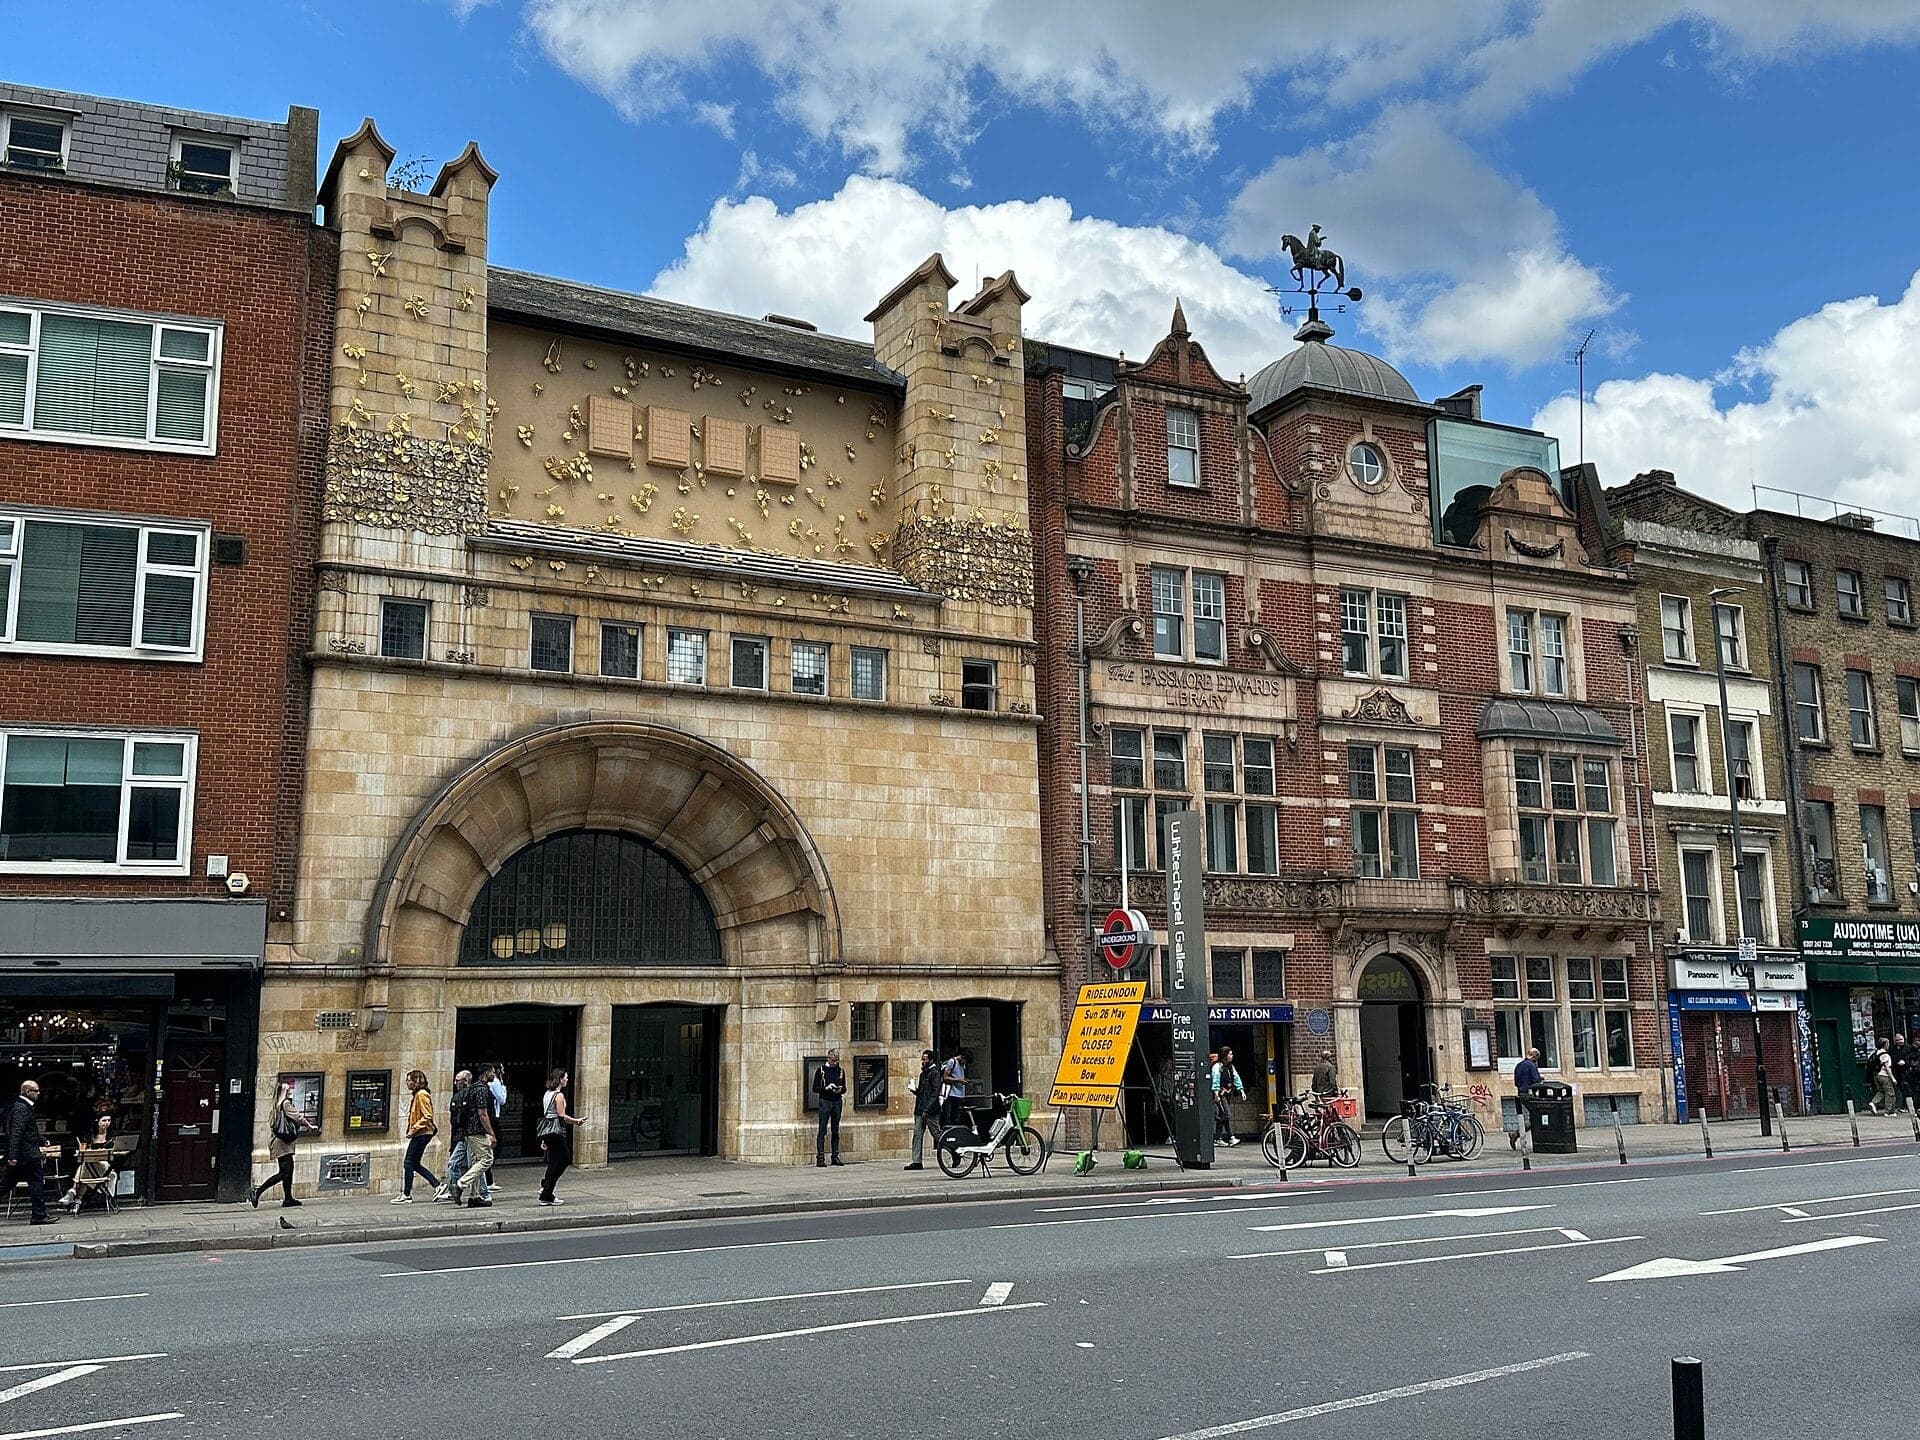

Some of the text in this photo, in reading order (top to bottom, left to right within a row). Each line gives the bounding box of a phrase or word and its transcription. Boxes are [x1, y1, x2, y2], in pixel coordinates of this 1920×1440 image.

[1280, 306, 1292, 315] W
[1338, 304, 1346, 314] E
[1142, 668, 1213, 690] PASSMORE
[1217, 674, 1280, 697] EDWARDS
[1166, 690, 1228, 710] LIBRARY
[1170, 820, 1186, 990] Whitechapel Gallery
[1833, 922, 1920, 942] AUDIOTIME (UK)
[1101, 934, 1136, 943] UNDERGROUND
[1687, 970, 1720, 979] Panasonic
[1764, 971, 1795, 980] Panasonic
[1086, 987, 1137, 999] RIDELONDON
[1084, 1008, 1127, 1020] Sun 26 May
[1173, 1013, 1191, 1024] Free
[1208, 1009, 1227, 1019] AST
[1230, 1009, 1270, 1019] STATION
[1094, 1026, 1106, 1036] and
[1108, 1025, 1122, 1036] A12
[1174, 1028, 1195, 1042] Entry
[1081, 1040, 1113, 1050] CLOSED
[1070, 1055, 1115, 1065] No access to
[1080, 1069, 1096, 1080] Bow
[1053, 1089, 1114, 1104] Plan your journey
